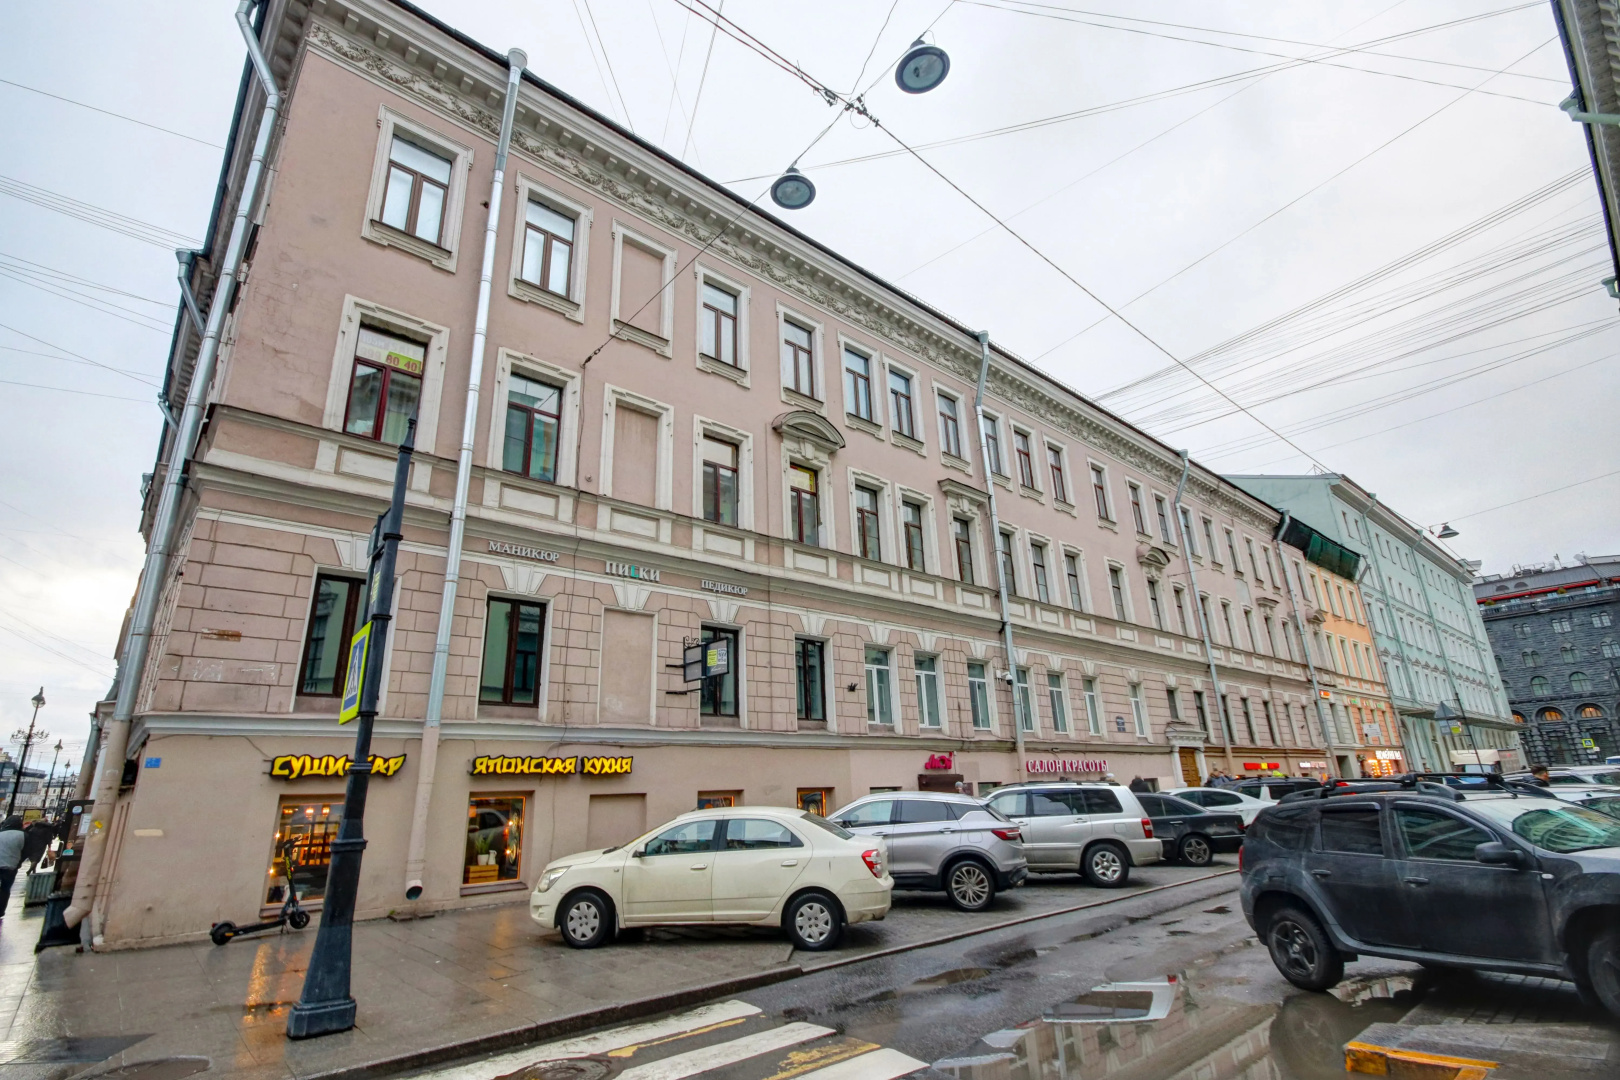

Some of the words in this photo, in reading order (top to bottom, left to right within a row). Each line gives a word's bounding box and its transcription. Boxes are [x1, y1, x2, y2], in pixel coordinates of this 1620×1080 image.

[386, 354, 400, 368] 80
[404, 360, 418, 372] 40
[488, 541, 560, 563] МАНИКЮР
[701, 580, 748, 596] ПЕДИКЮР
[272, 755, 406, 779] СУШИ-АР
[473, 756, 577, 775] ЯПОНСКАЯ
[582, 756, 633, 775] КУХНЯ
[1027, 759, 1063, 773] САЛОН
[1065, 759, 1109, 772] КРАСОТЫ
